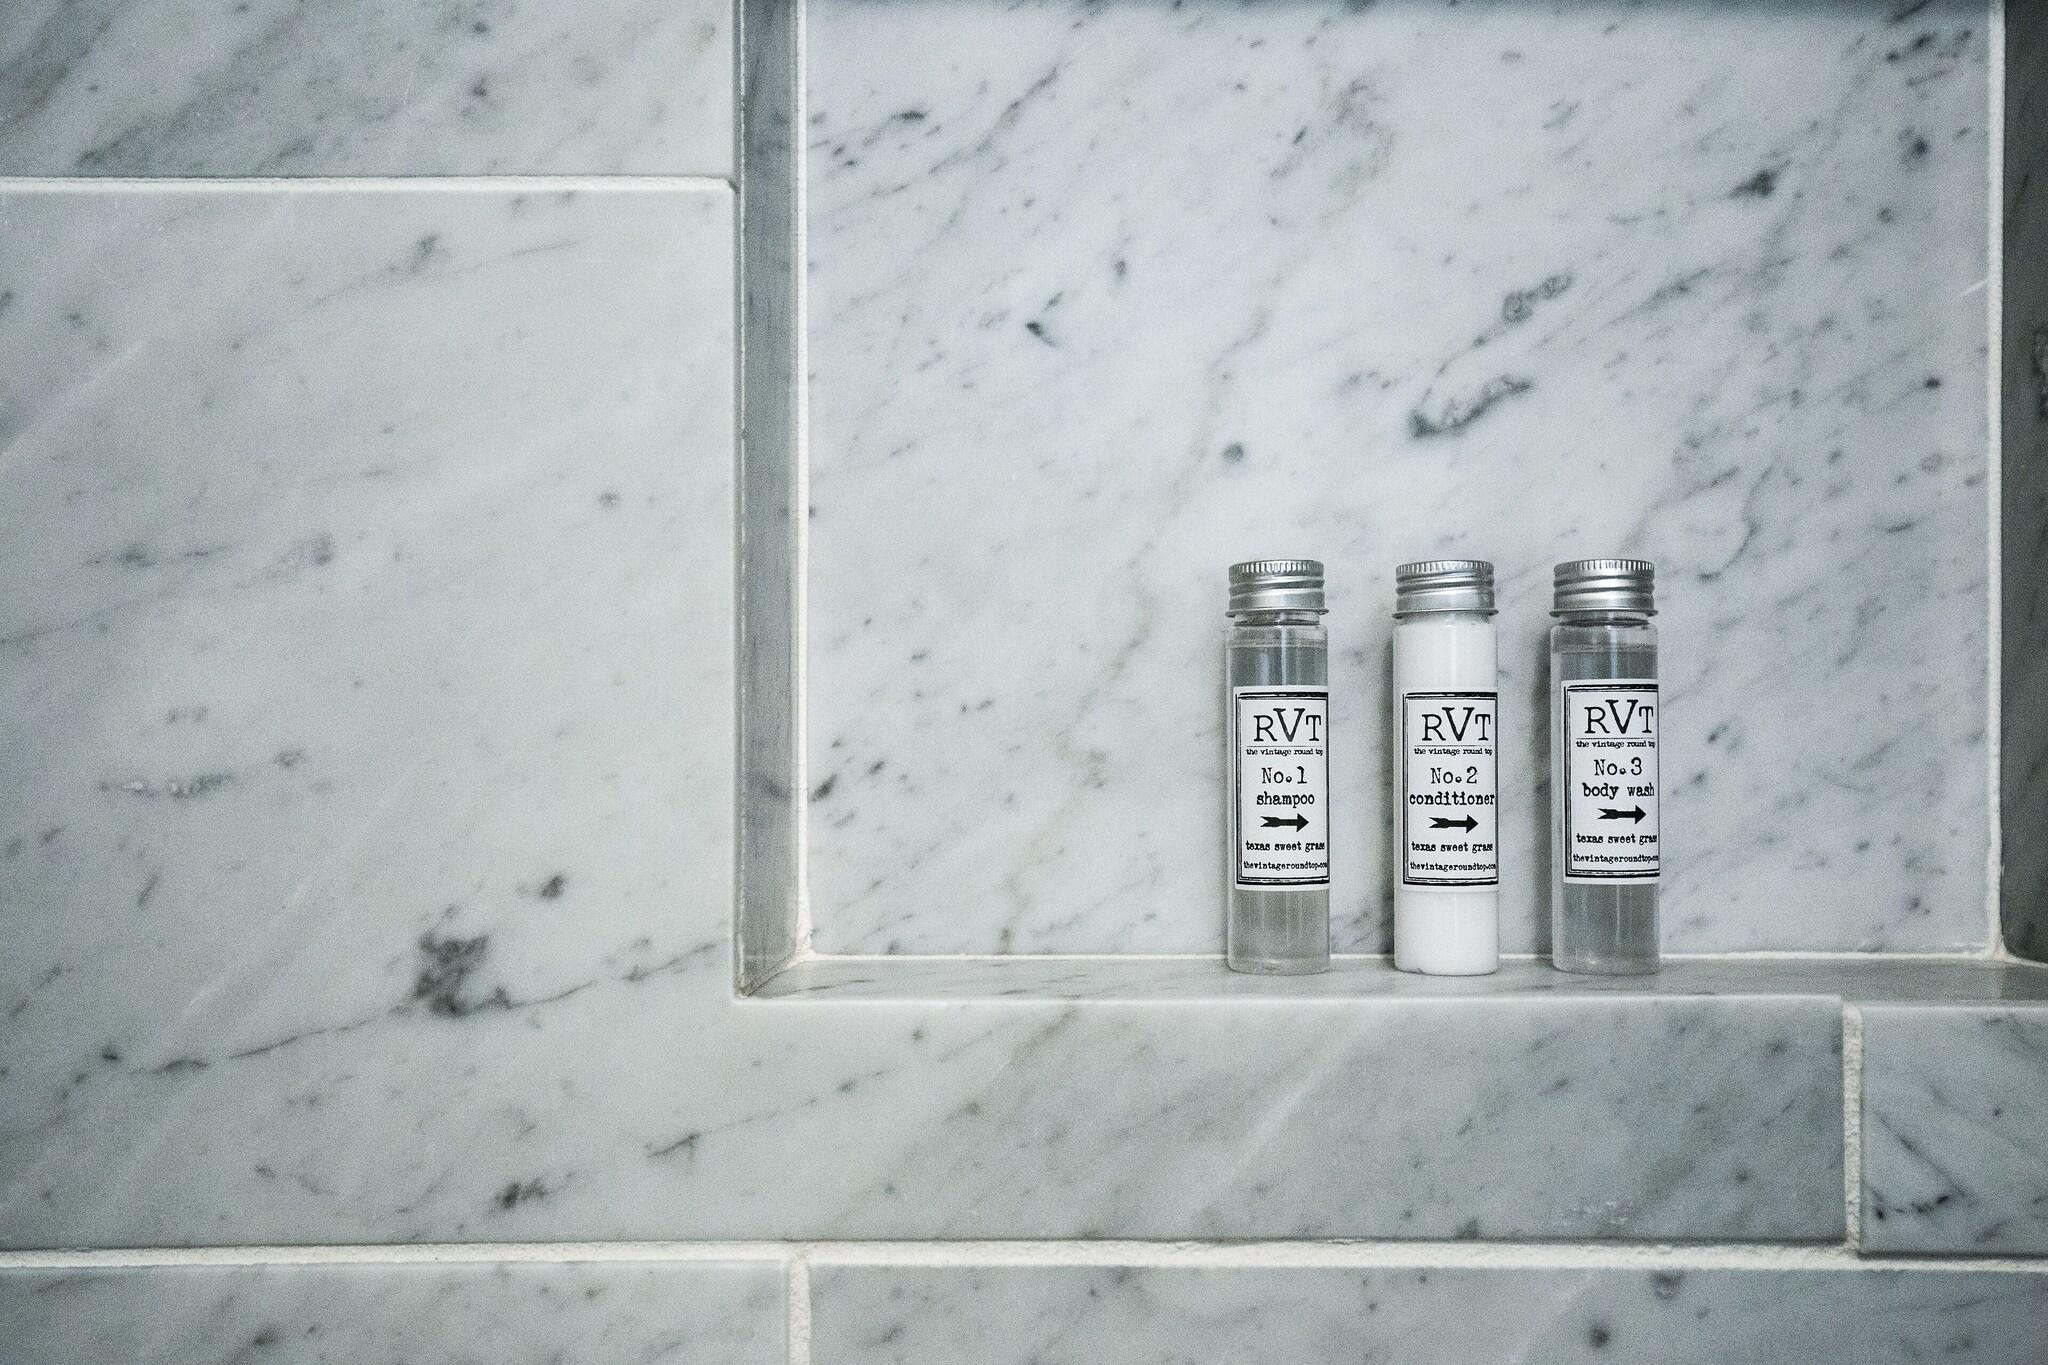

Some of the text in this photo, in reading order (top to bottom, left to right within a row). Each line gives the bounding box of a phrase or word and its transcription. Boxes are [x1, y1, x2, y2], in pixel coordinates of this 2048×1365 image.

[1584, 699, 1654, 734] RVT
[1253, 708, 1322, 742] RVT
[1421, 707, 1491, 742] RVT
[1591, 741, 1625, 749] vintage
[1627, 740, 1647, 748] round
[1246, 748, 1258, 756] the
[1261, 748, 1292, 756] vintage
[1428, 748, 1460, 756] vintage
[1582, 782, 1655, 800] body wash
[1256, 790, 1315, 808] shampoo
[1409, 791, 1495, 806] conditioner
[1576, 833, 1604, 843] texas
[1608, 833, 1636, 844] sweet
[1245, 840, 1271, 850] texas
[1274, 841, 1302, 851] sweet
[1411, 841, 1437, 851] texas
[1440, 841, 1468, 852] sweet
